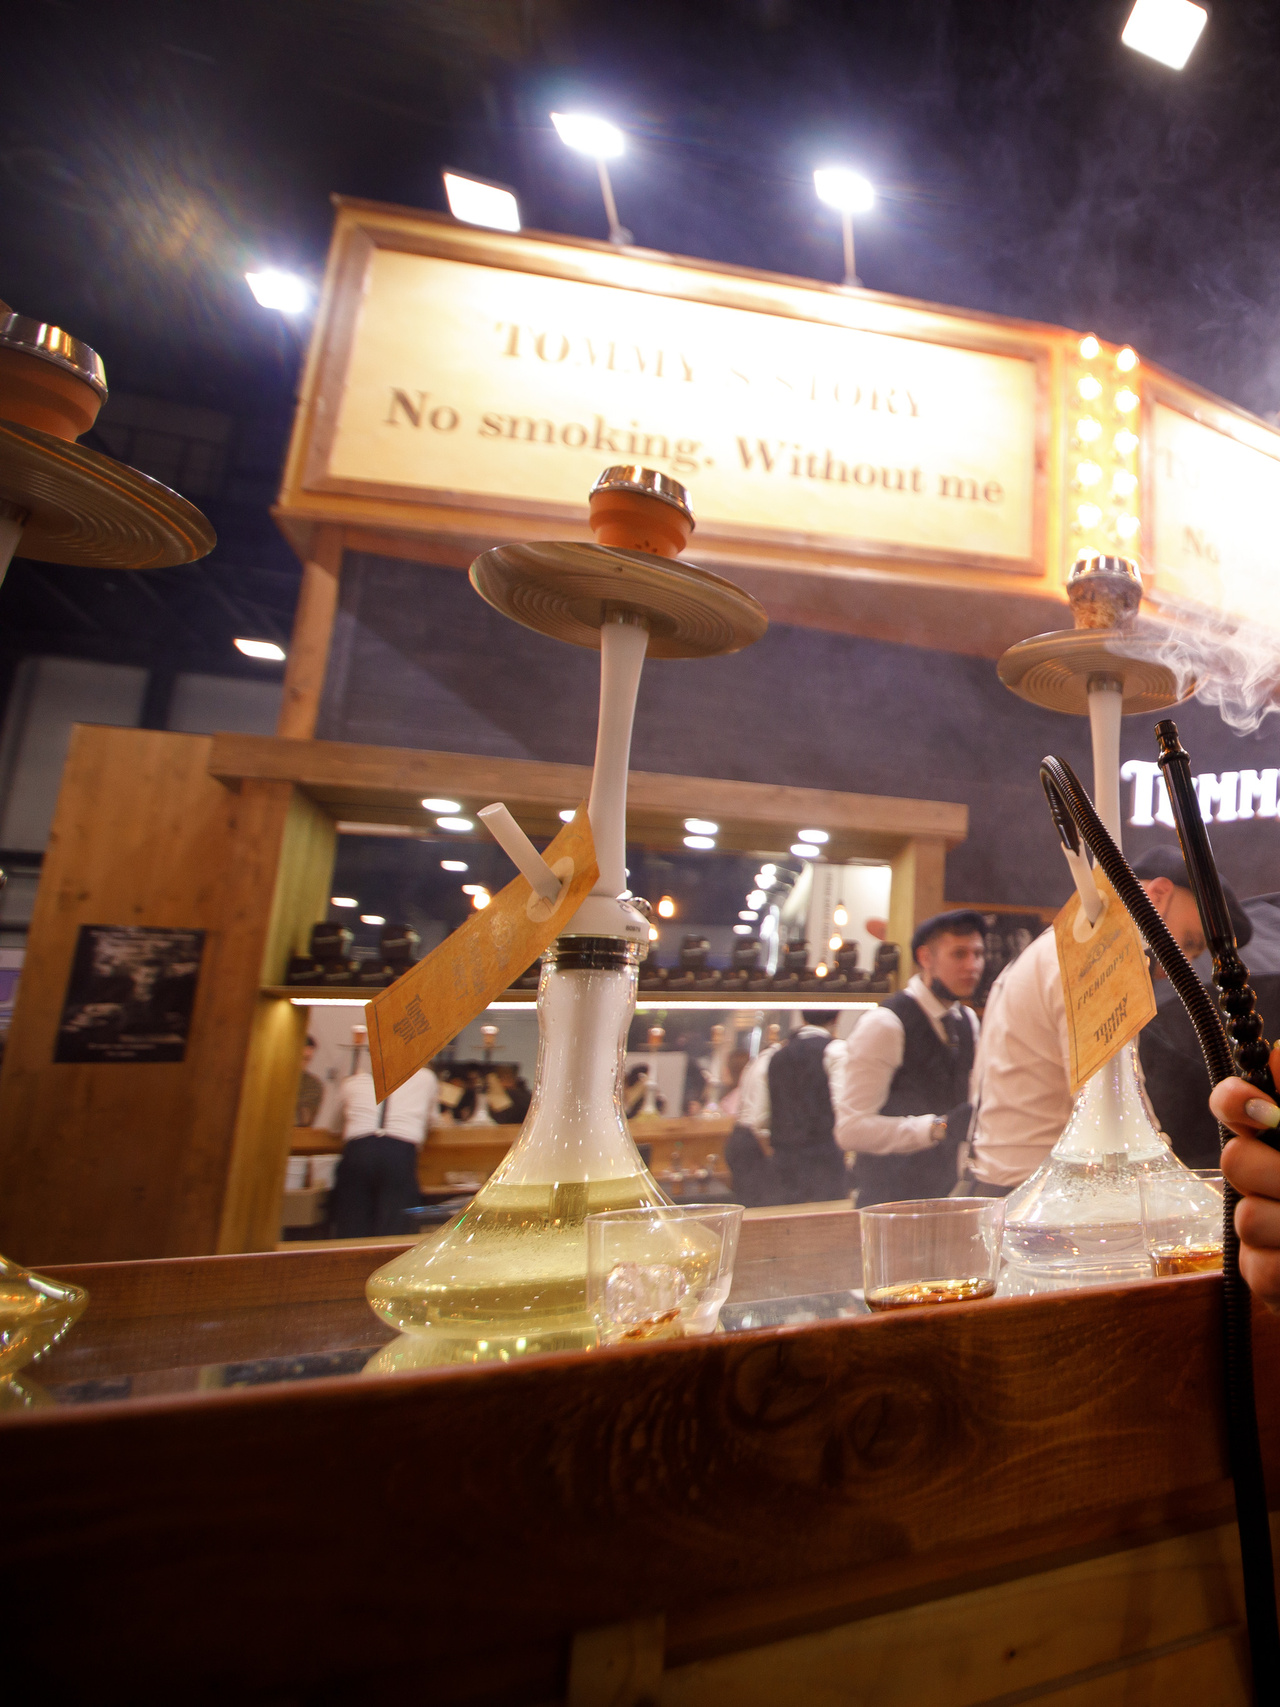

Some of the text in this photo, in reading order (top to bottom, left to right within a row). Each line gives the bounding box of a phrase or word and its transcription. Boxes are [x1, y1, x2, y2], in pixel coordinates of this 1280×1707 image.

[493, 321, 698, 383] TOMMY
[382, 385, 1004, 502] No smoking. Without me
[1093, 993, 1129, 1043] TOMMY
